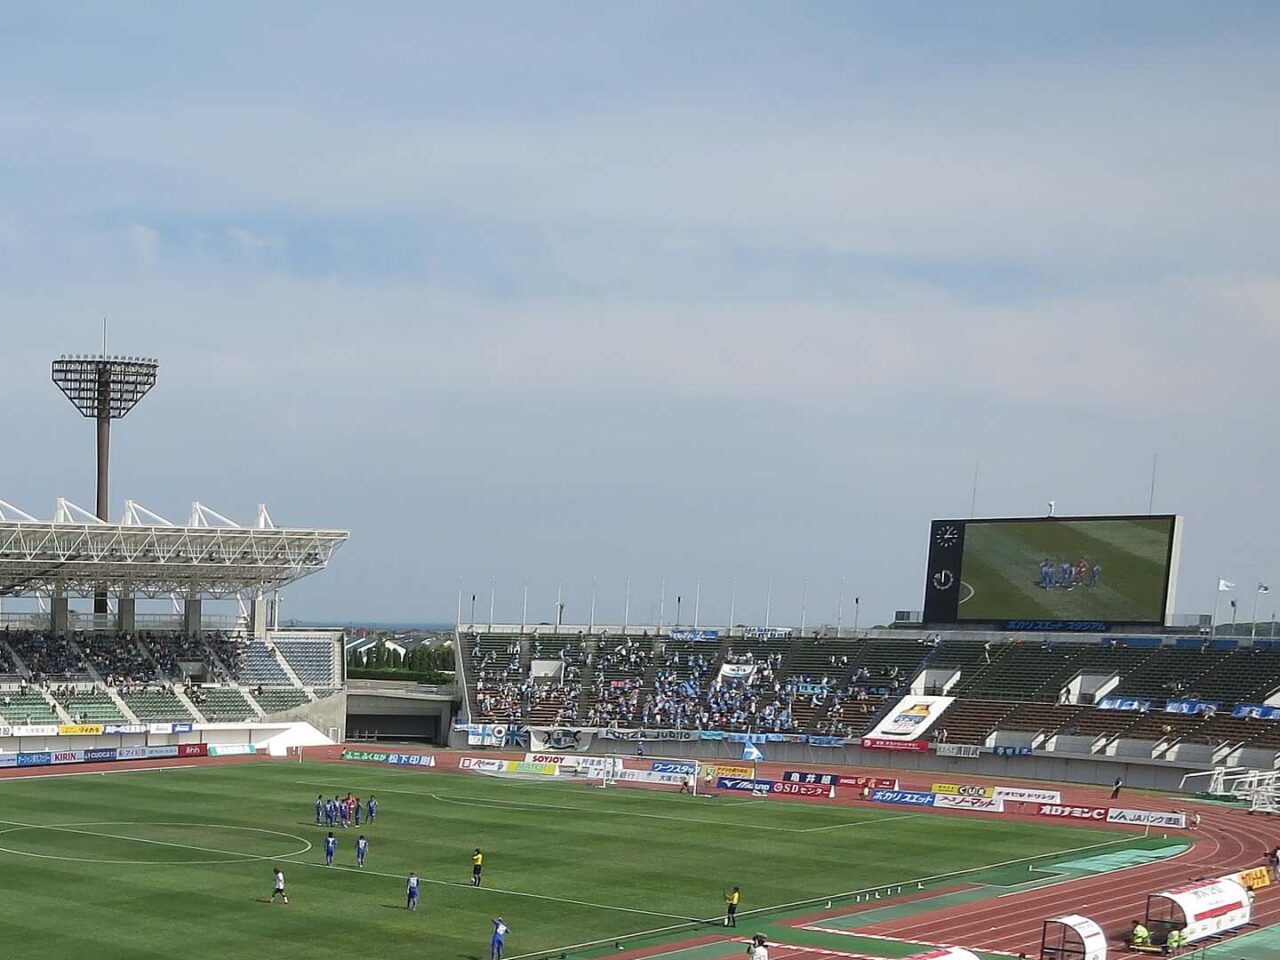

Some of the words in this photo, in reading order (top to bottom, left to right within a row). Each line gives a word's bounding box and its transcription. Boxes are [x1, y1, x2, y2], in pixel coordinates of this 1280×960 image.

[55, 753, 76, 761] KIRIN
[532, 755, 565, 763] SOYJOY
[959, 786, 985, 795] CUE
